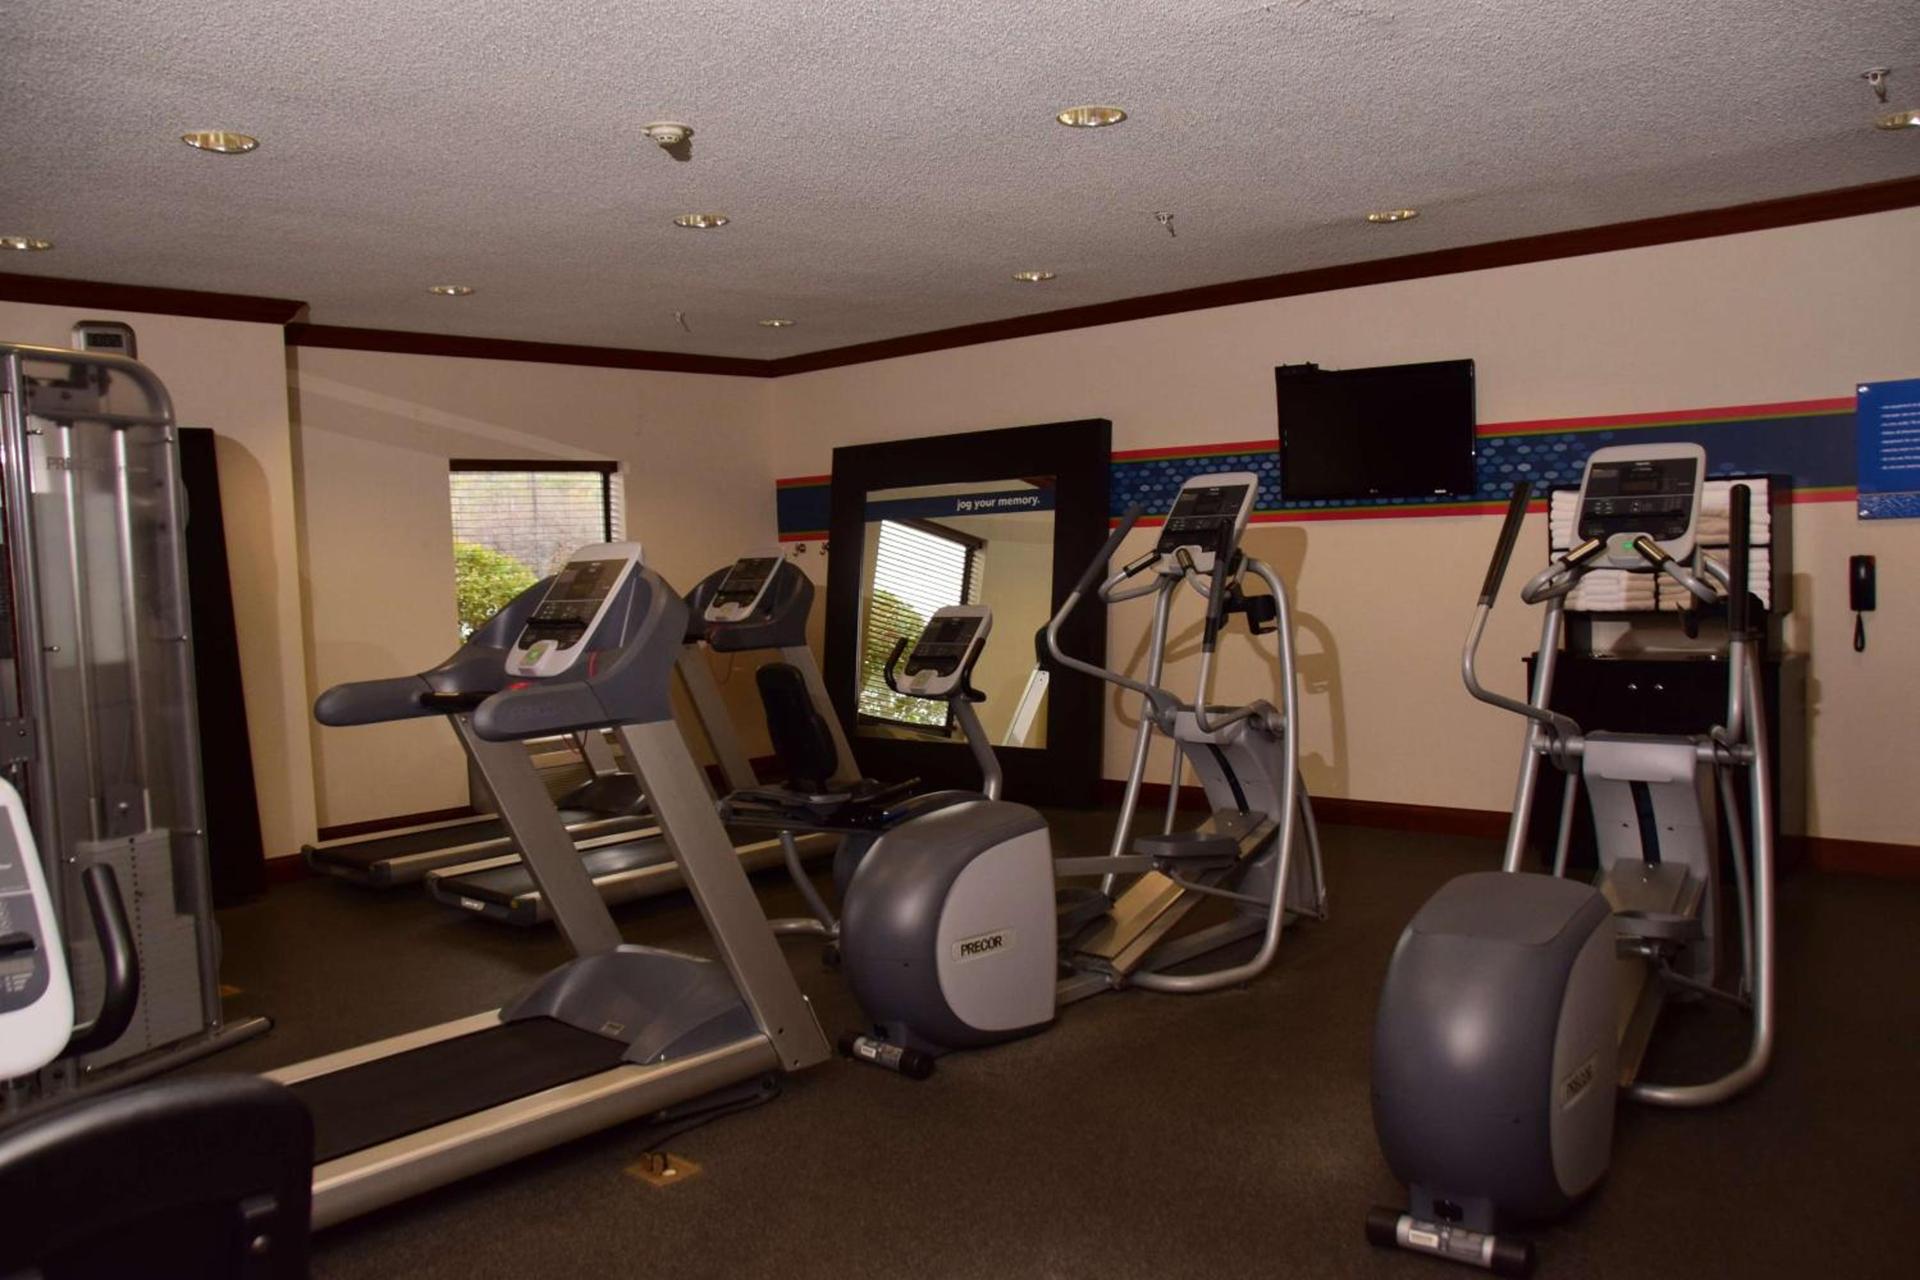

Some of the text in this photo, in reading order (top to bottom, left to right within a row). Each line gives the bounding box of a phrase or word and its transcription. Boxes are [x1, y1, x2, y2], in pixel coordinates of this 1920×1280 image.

[956, 495, 1040, 511] jog your memory.
[960, 935, 1002, 957] PRECOR
